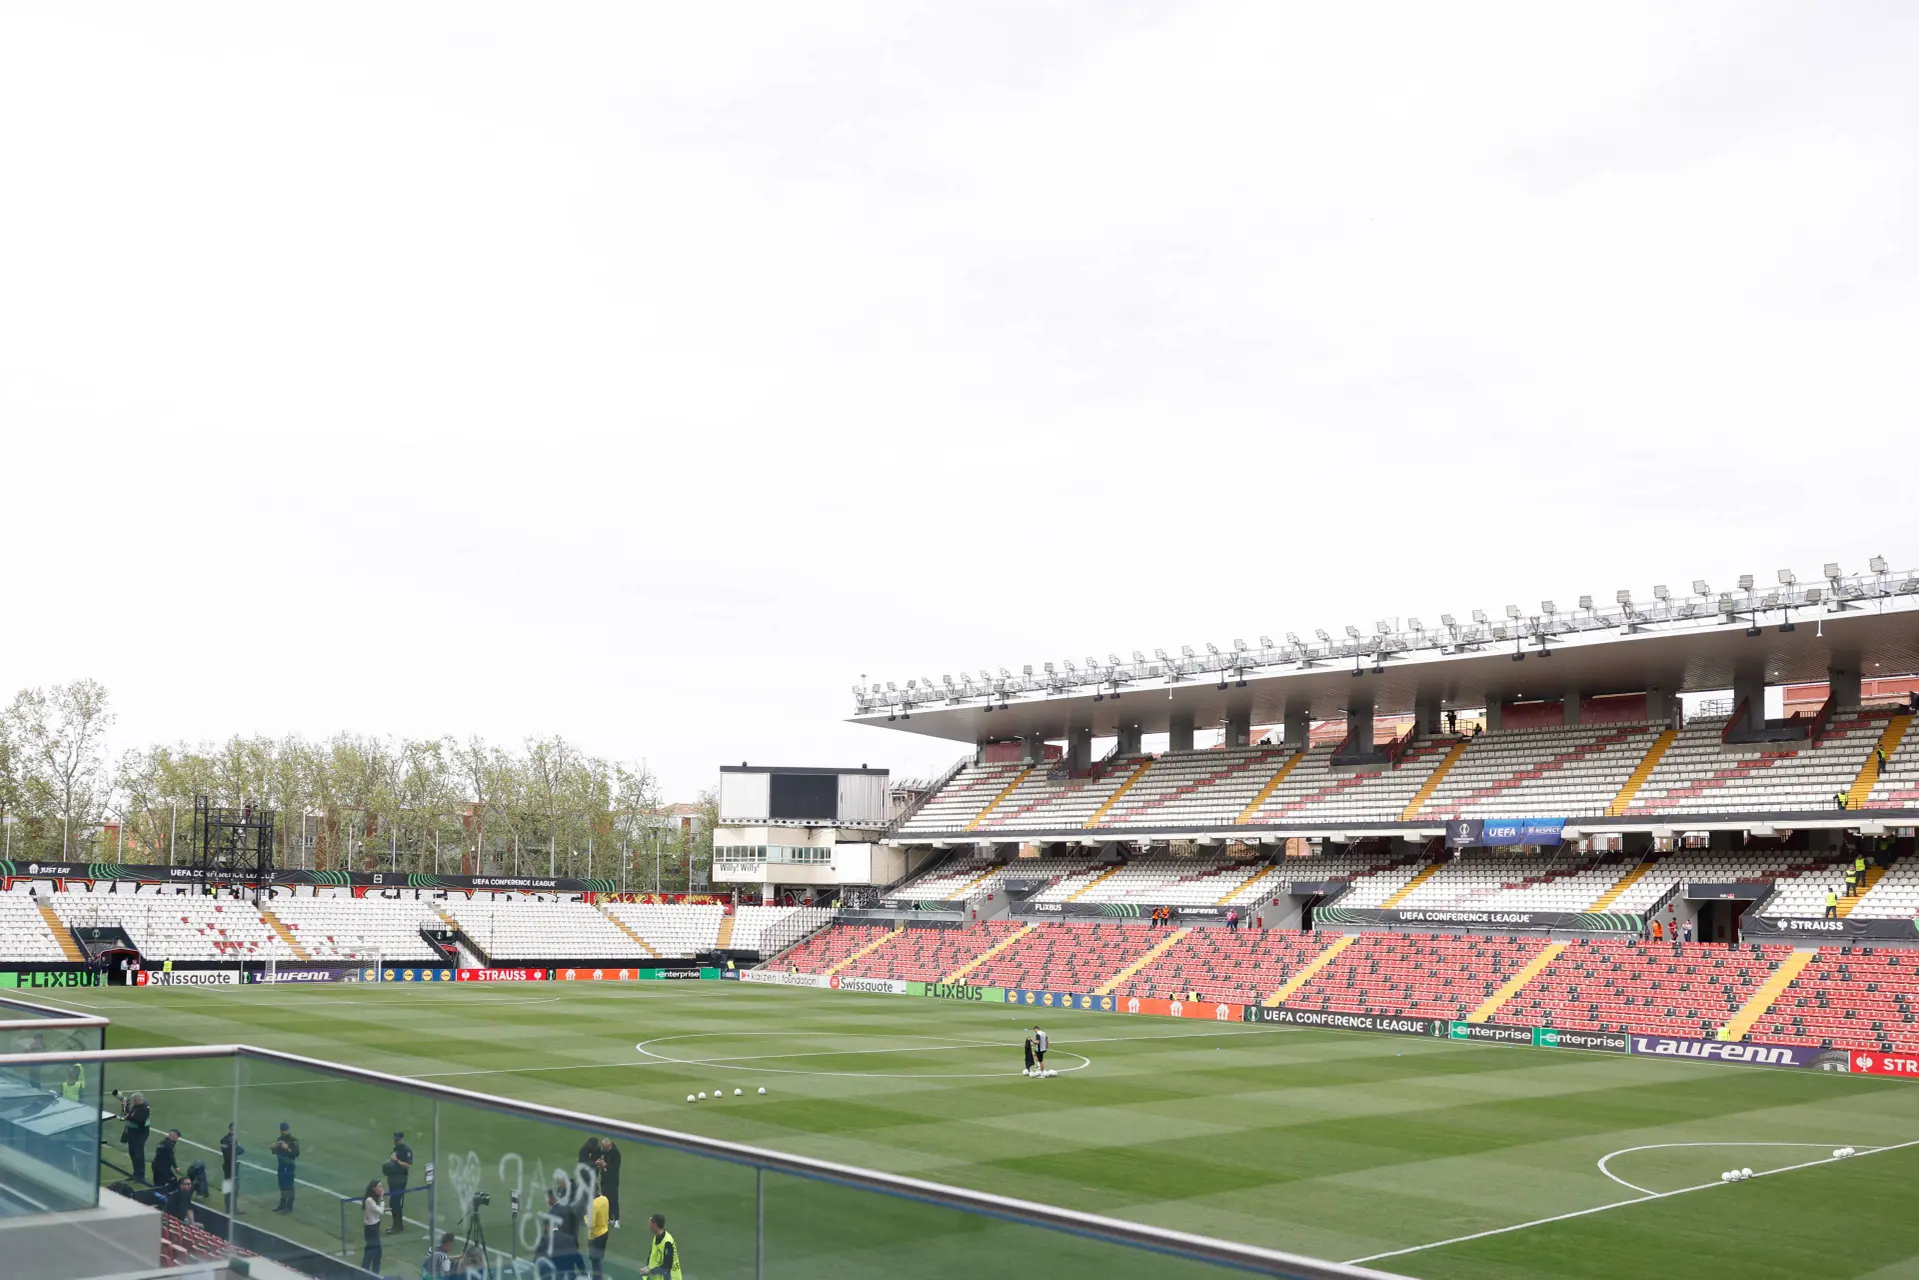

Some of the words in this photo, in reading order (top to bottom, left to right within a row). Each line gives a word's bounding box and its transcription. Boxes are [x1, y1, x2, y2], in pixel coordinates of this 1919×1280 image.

[1489, 828, 1516, 837] UEFA
[170, 869, 192, 877] UEFA
[472, 878, 490, 886] UEFA
[491, 879, 531, 887] CONFERENCE
[532, 880, 556, 888] LEAGUE
[1400, 912, 1424, 920] UEFA
[1426, 912, 1488, 922] CONFERENCE
[1491, 913, 1530, 923] LEAGUE
[1790, 920, 1844, 931] STRAUSS
[17, 971, 99, 988] FLiXBU
[478, 970, 527, 981] STRAUSS
[656, 970, 700, 979] enterprise
[751, 973, 777, 982] kaizen
[782, 974, 817, 986] foundation
[840, 977, 893, 993] Swissquote
[924, 982, 983, 1001] FLiXBUS
[1264, 1010, 1294, 1022] UEFA
[1296, 1013, 1373, 1029] CONFERENCE
[1376, 1019, 1424, 1033] LEAGUE
[1452, 1026, 1531, 1040] enterprise
[1540, 1034, 1625, 1048] enterprise
[1883, 1058, 1919, 1073] STR
